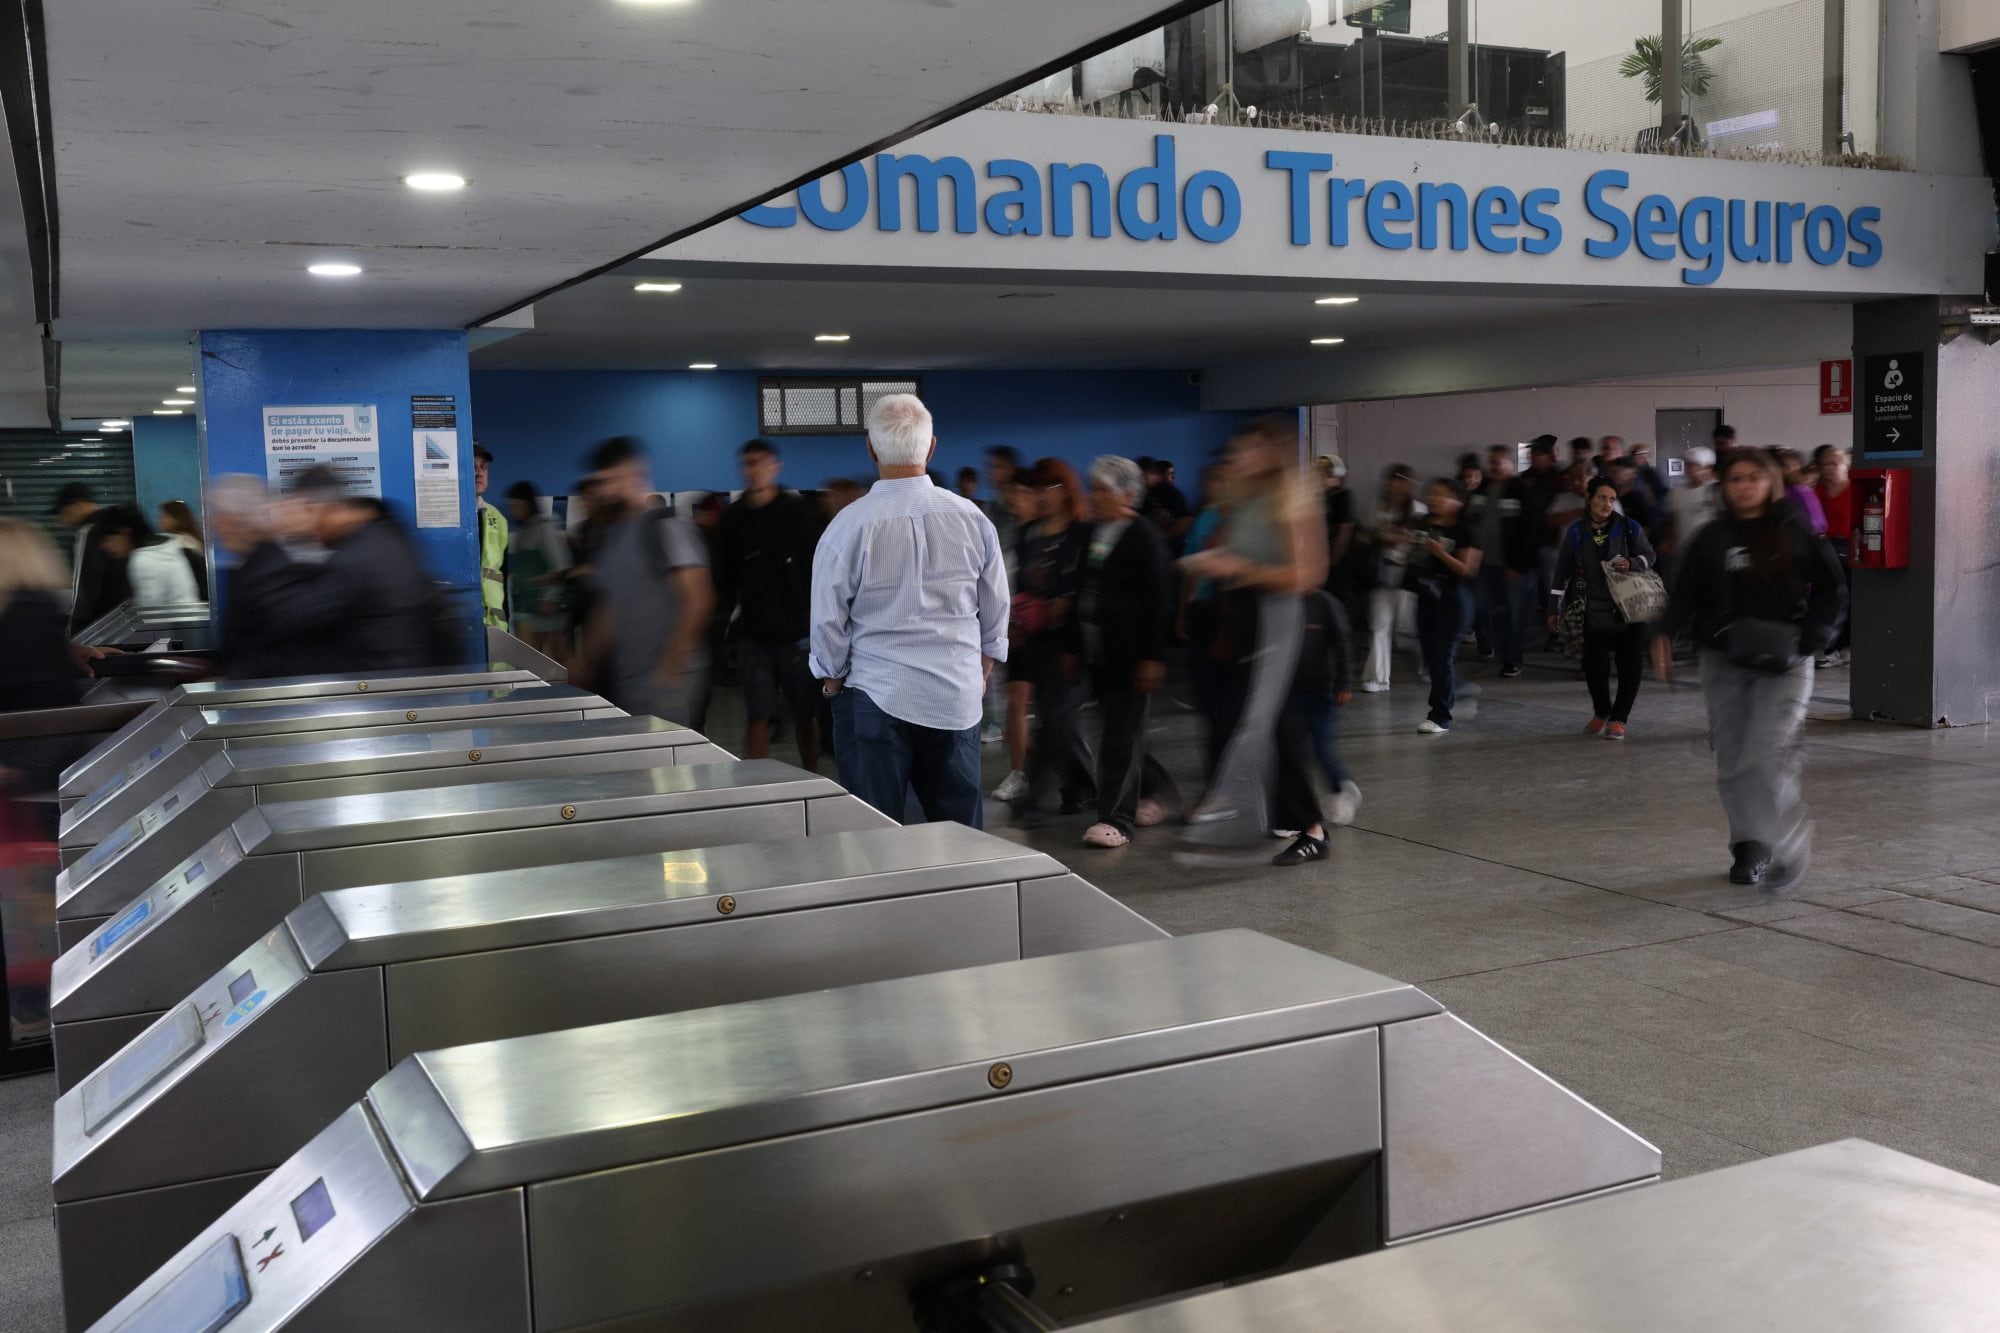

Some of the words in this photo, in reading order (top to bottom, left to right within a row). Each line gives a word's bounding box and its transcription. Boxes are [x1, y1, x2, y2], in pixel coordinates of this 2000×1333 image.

[1266, 150, 1563, 254] Trenes
[1584, 169, 1883, 286] Seguros
[1875, 393, 1902, 404] Espacio
[1903, 393, 1913, 401] de
[1875, 403, 1909, 413] Lactancia
[281, 415, 308, 425] estás
[309, 416, 341, 425] exento
[271, 427, 283, 435] de
[285, 428, 312, 437] pagar
[314, 427, 325, 435] tu
[326, 426, 352, 436] viaje,
